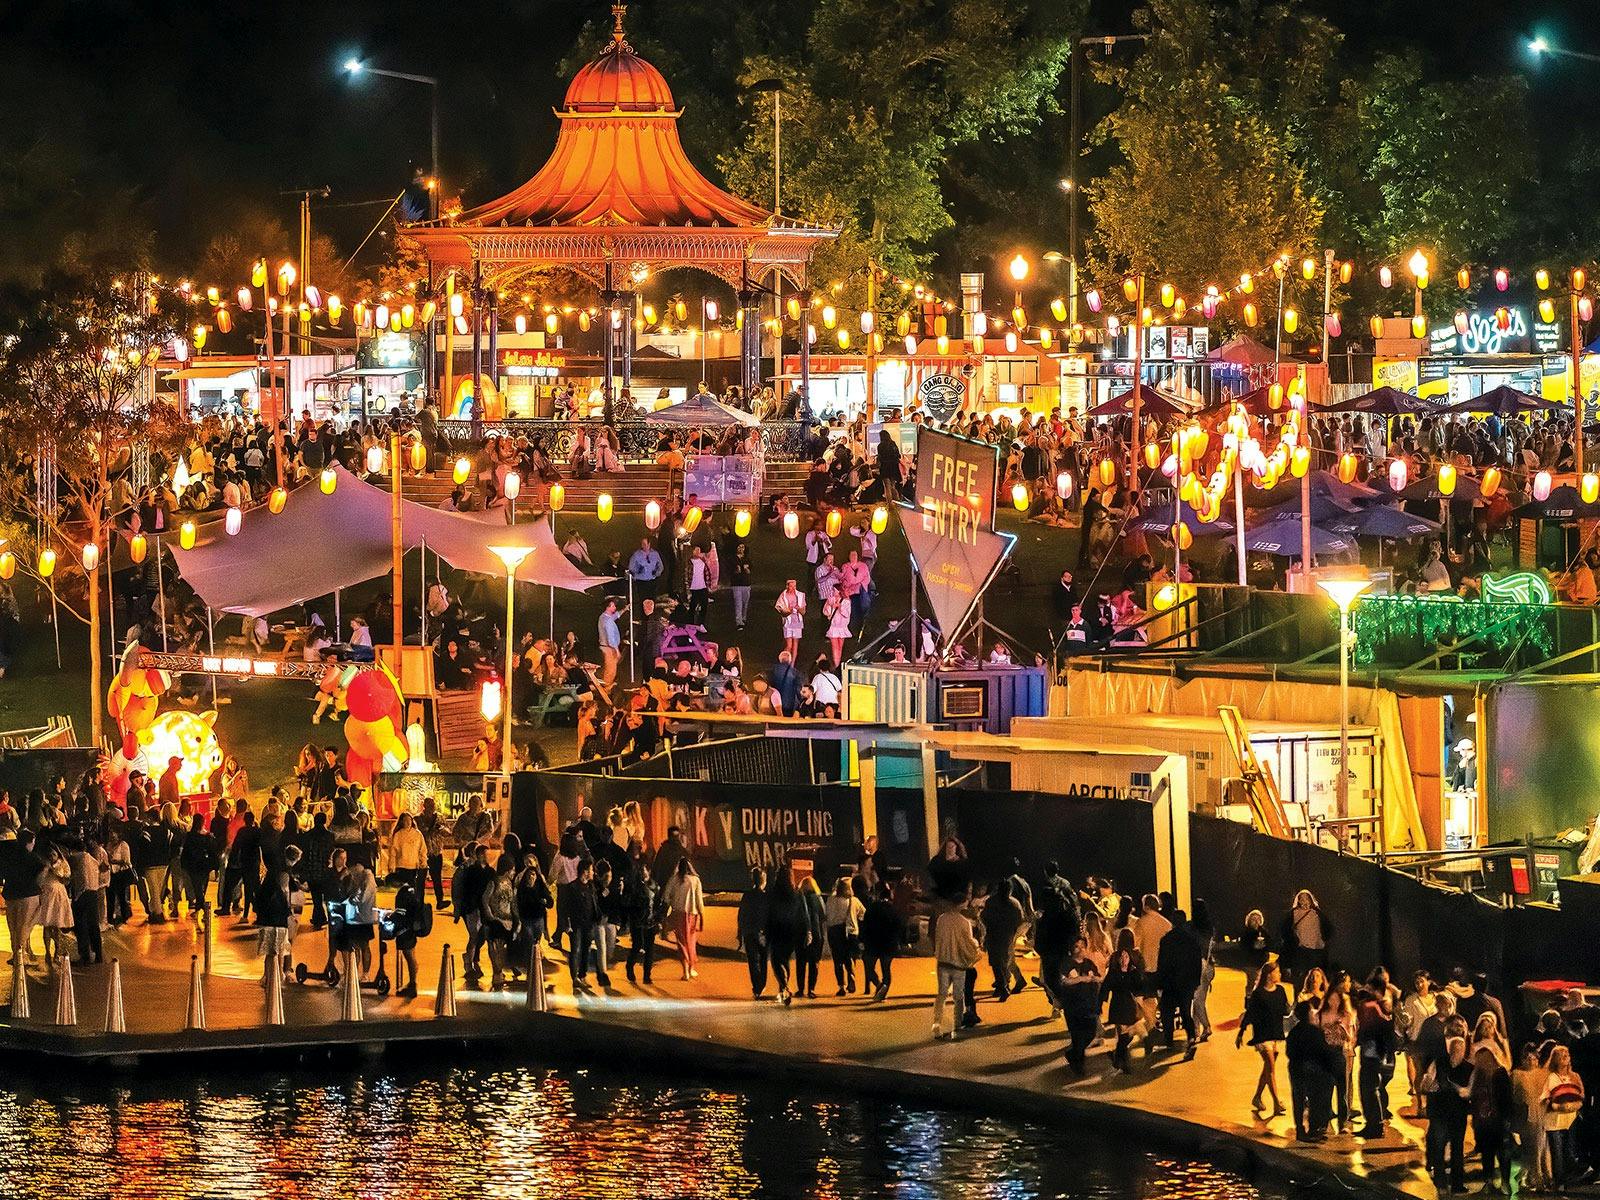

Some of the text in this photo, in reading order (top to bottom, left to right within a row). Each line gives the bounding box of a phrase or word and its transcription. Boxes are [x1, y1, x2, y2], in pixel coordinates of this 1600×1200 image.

[923, 377, 942, 392] GANG
[931, 453, 979, 497] FREE
[922, 496, 982, 546] ENTRY
[741, 808, 833, 837] DUMPLING
